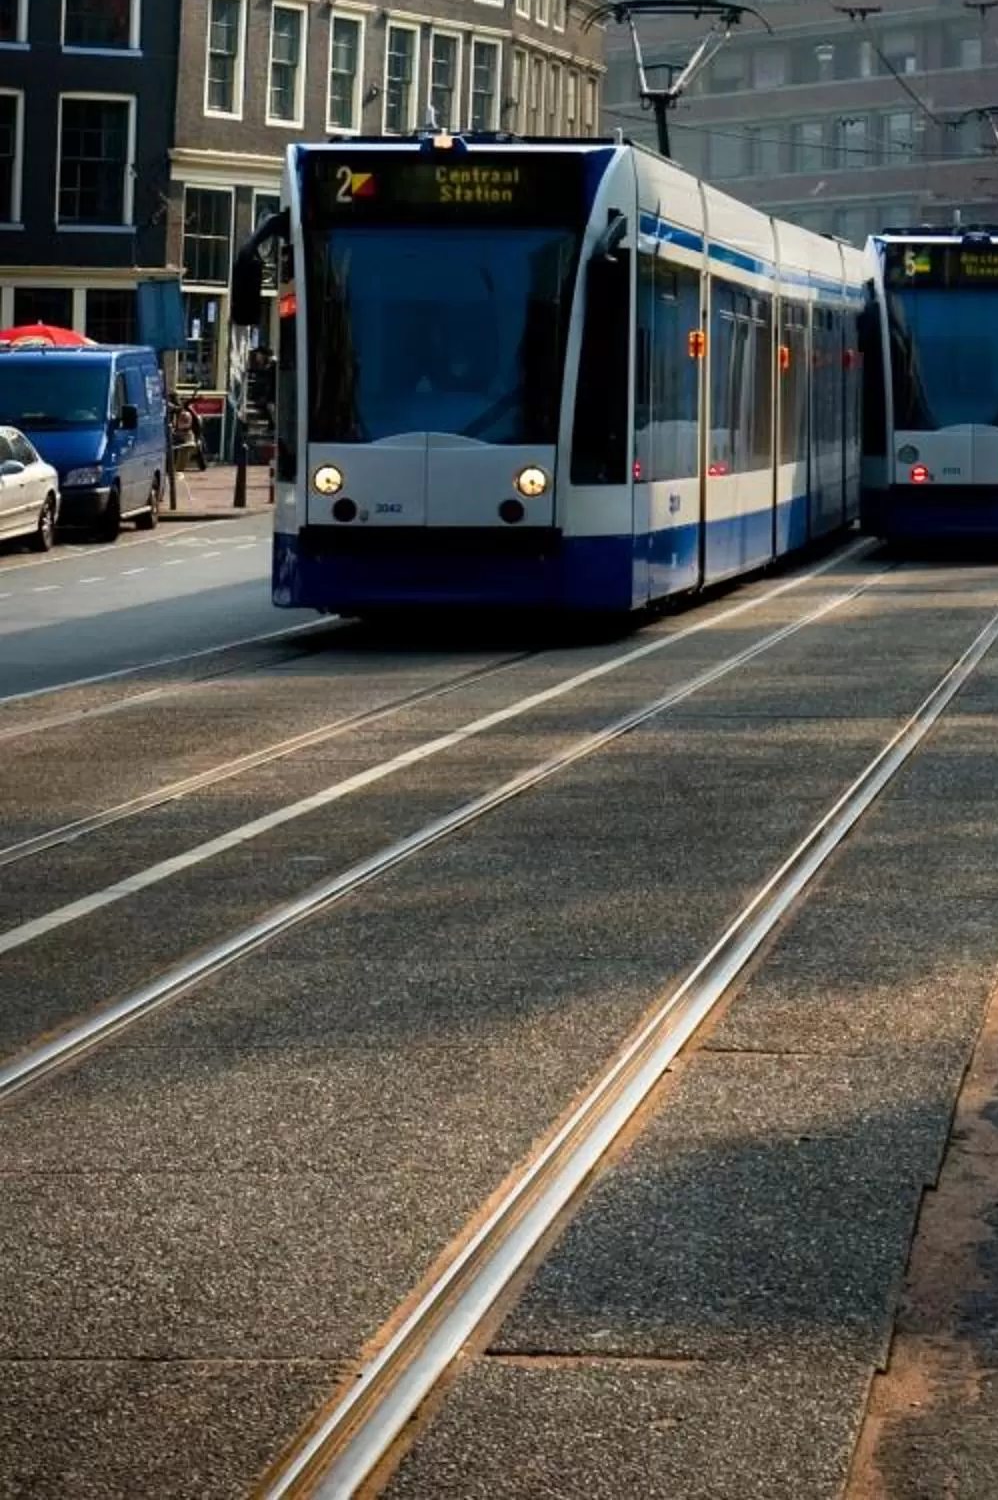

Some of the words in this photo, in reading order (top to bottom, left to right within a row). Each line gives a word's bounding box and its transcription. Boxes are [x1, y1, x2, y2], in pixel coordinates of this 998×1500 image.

[434, 165, 521, 183] Centraal
[336, 165, 353, 203] 2
[439, 184, 513, 202] Station
